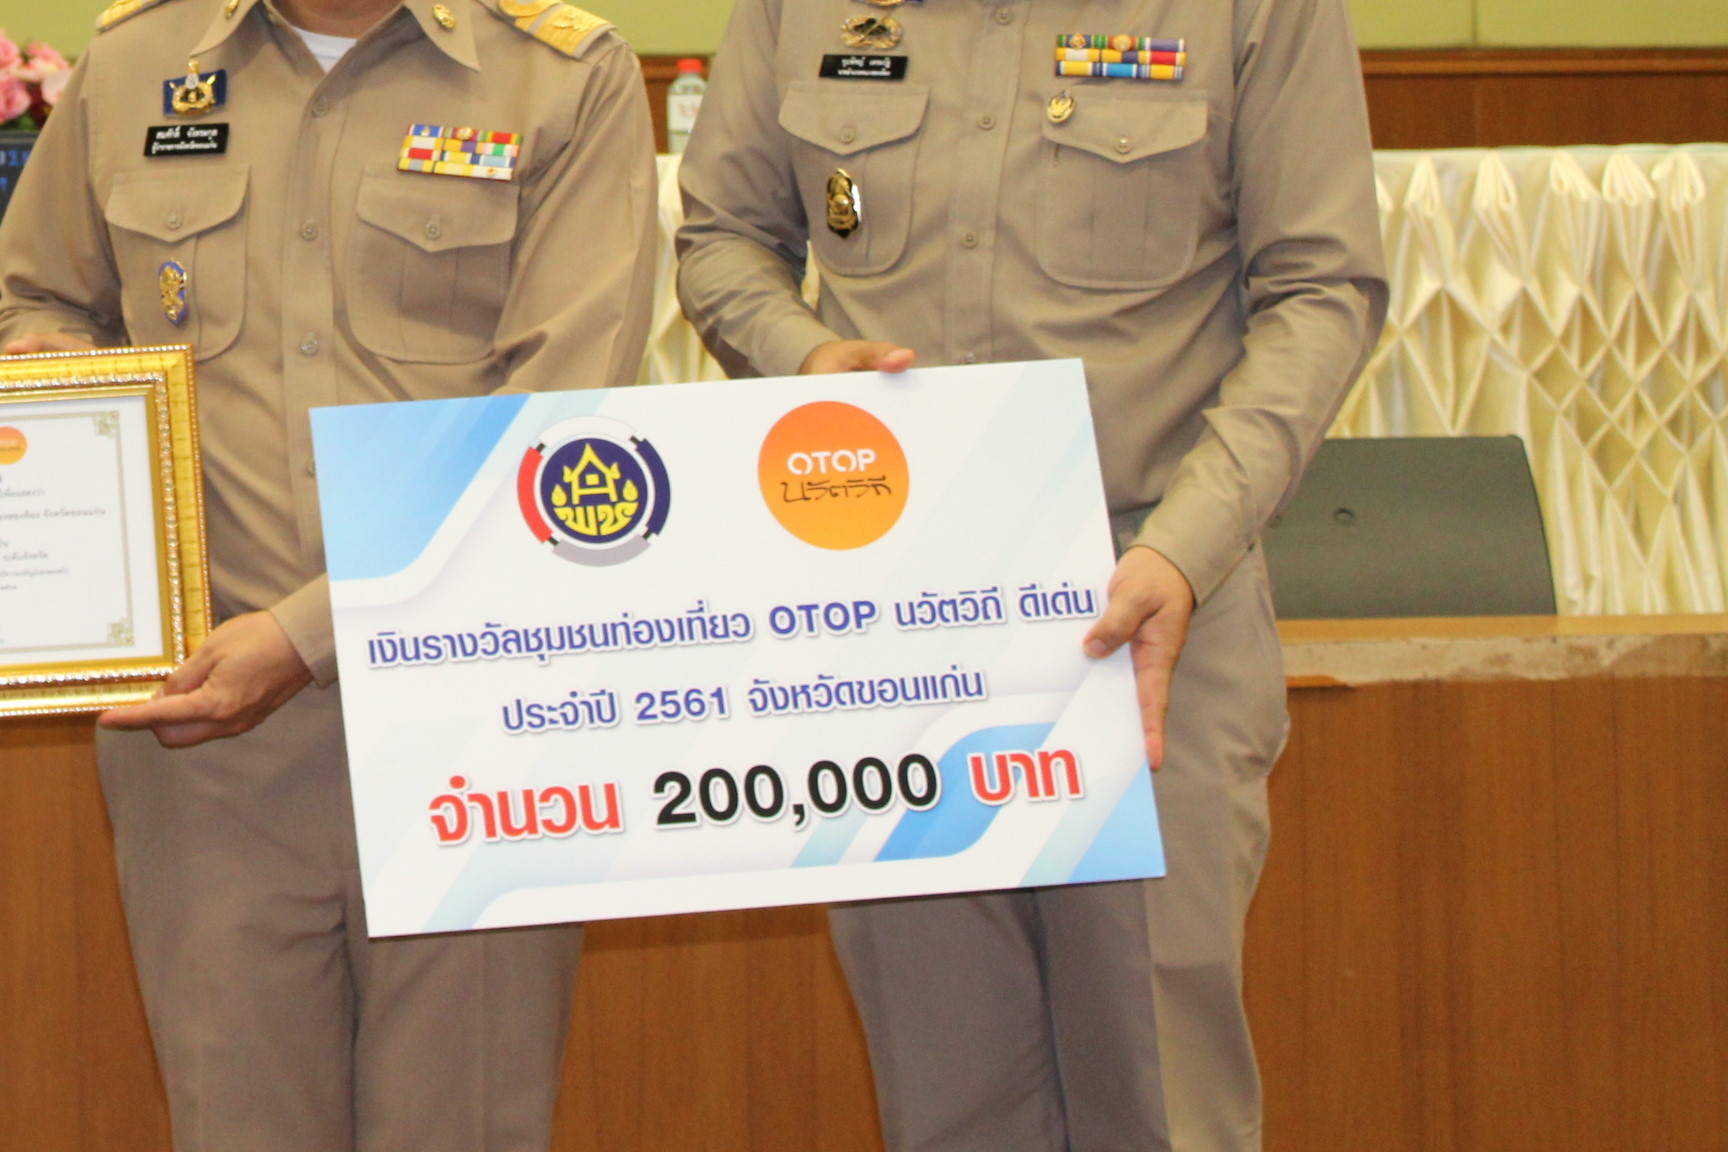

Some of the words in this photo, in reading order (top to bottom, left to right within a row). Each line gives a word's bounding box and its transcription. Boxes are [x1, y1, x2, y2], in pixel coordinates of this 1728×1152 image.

[786, 448, 877, 476] OTOP
[368, 599, 752, 664] เงินรางวัลชุมชนท่องเที่ยว
[770, 599, 877, 635] OTOP
[894, 586, 1003, 627] นวัตวิถี
[1018, 581, 1095, 618] ดีเด่น
[501, 688, 617, 731] ประจำปี
[634, 686, 727, 721] 2561
[747, 664, 985, 713] จังหวัดขอนแก่น
[428, 774, 621, 842] จำนวน
[652, 753, 938, 827] 200,000
[969, 748, 1081, 803] บาท
